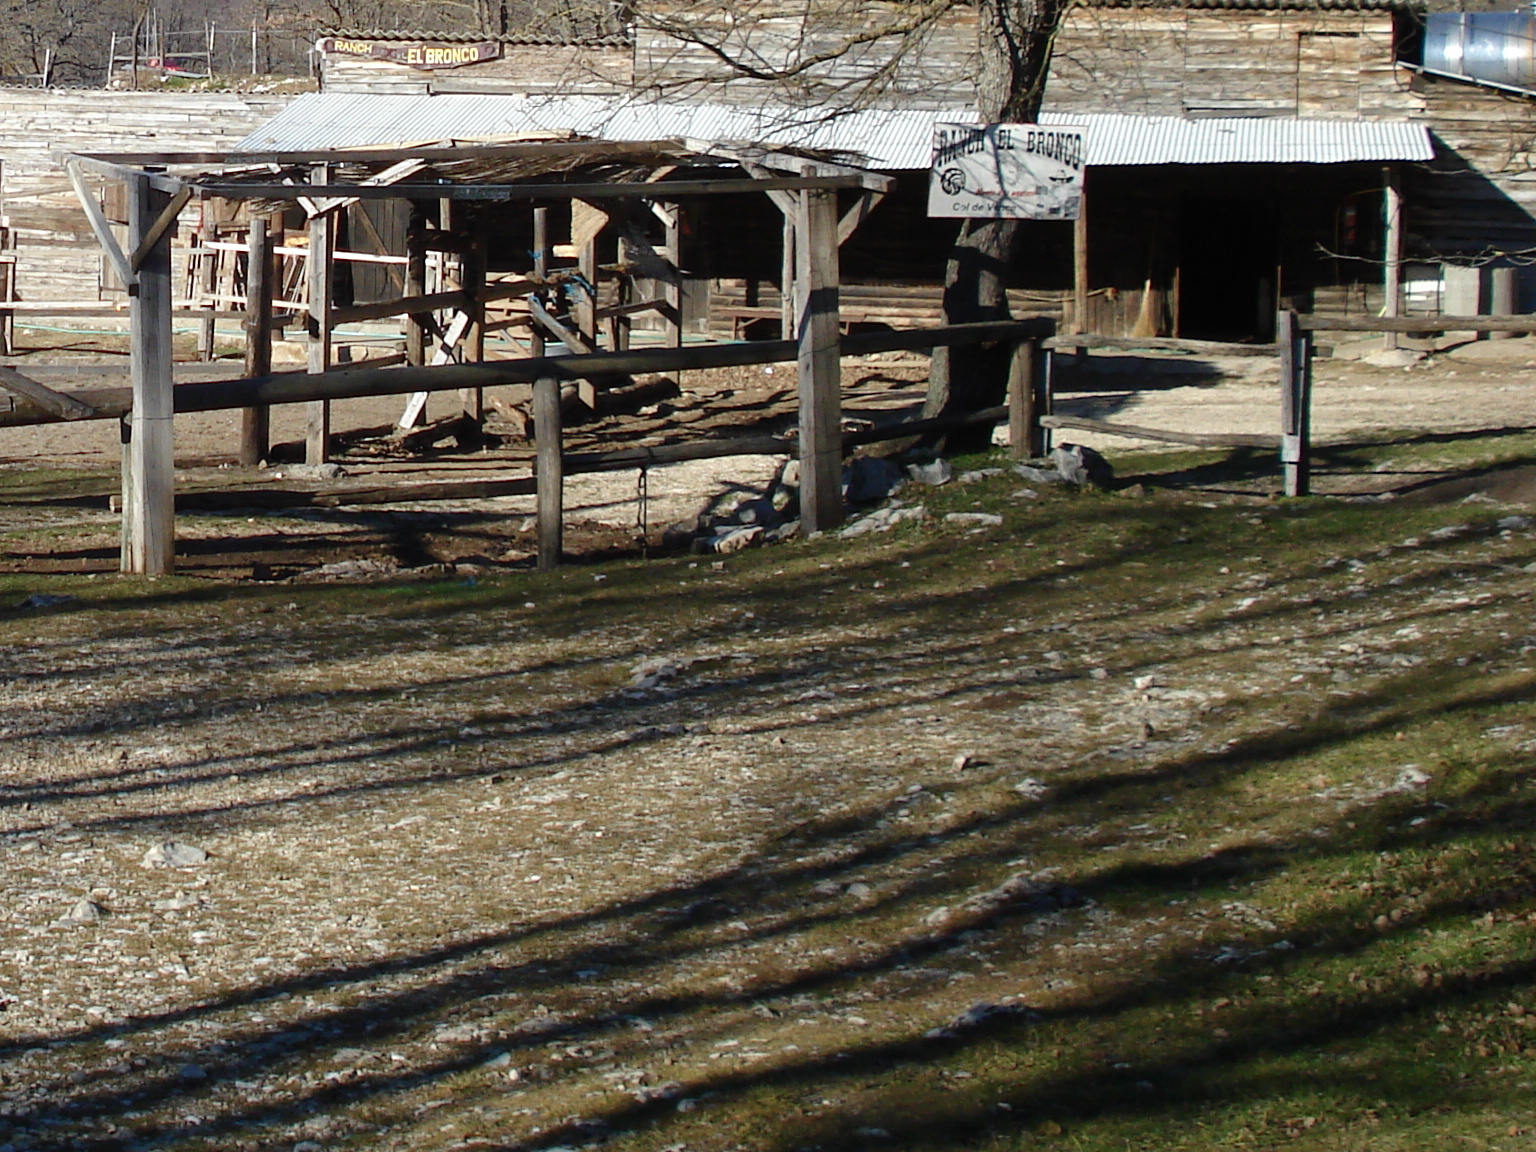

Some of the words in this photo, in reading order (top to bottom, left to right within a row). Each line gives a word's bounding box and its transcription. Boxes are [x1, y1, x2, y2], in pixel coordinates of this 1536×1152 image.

[334, 40, 373, 54] RANCH
[937, 130, 985, 167] RANCH
[997, 129, 1015, 150] EL
[1026, 130, 1082, 171] BRONCO
